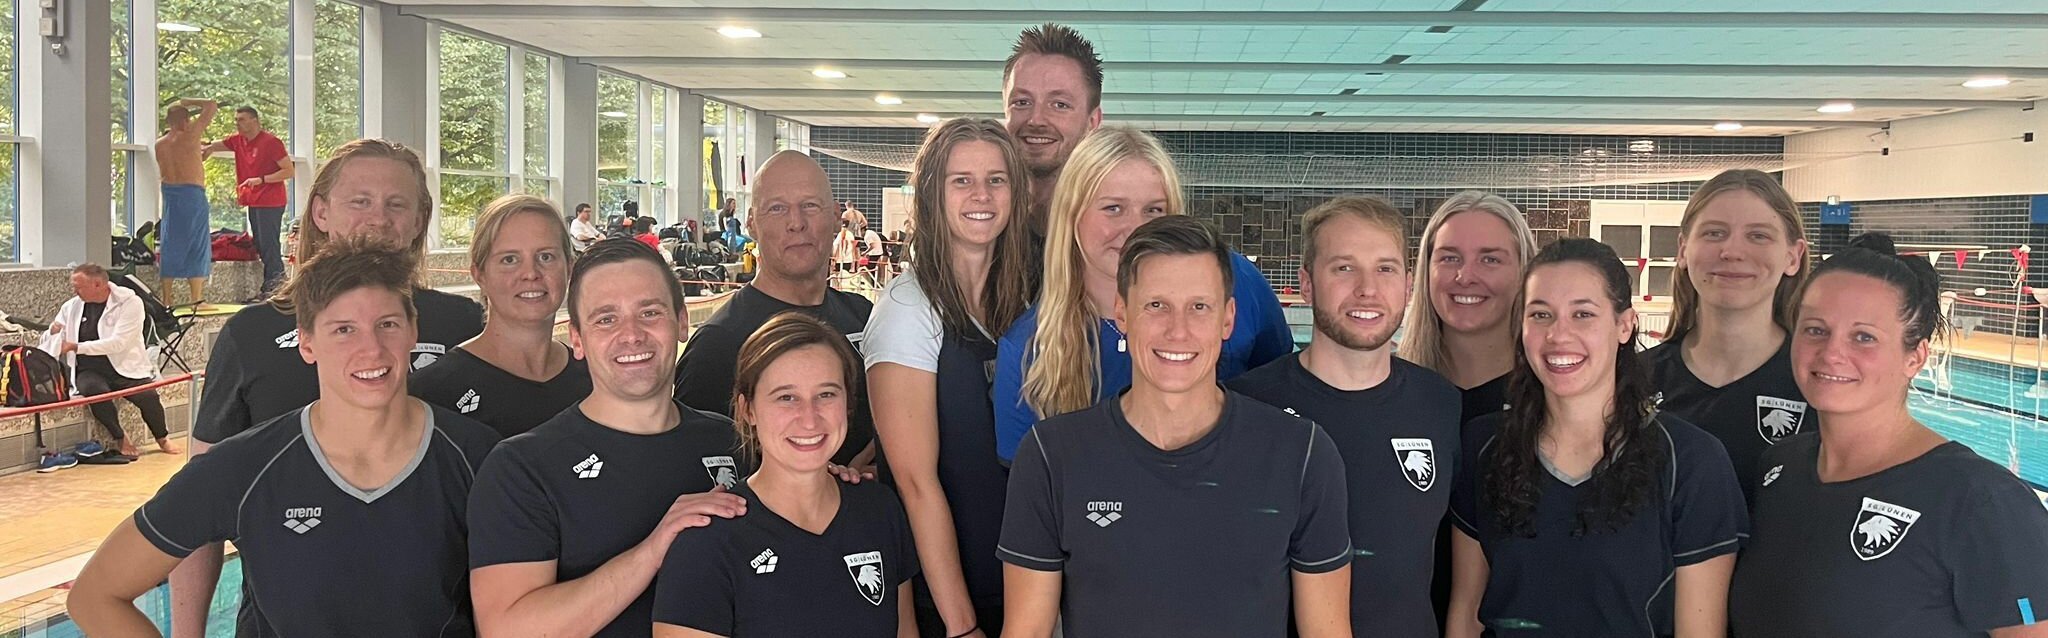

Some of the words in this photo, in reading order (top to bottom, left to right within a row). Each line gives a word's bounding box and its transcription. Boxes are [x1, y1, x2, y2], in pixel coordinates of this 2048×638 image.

[456, 388, 476, 409] arena
[572, 453, 599, 474] arena
[285, 507, 322, 519] arena
[1087, 501, 1123, 511] arena
[750, 547, 775, 569] arena
